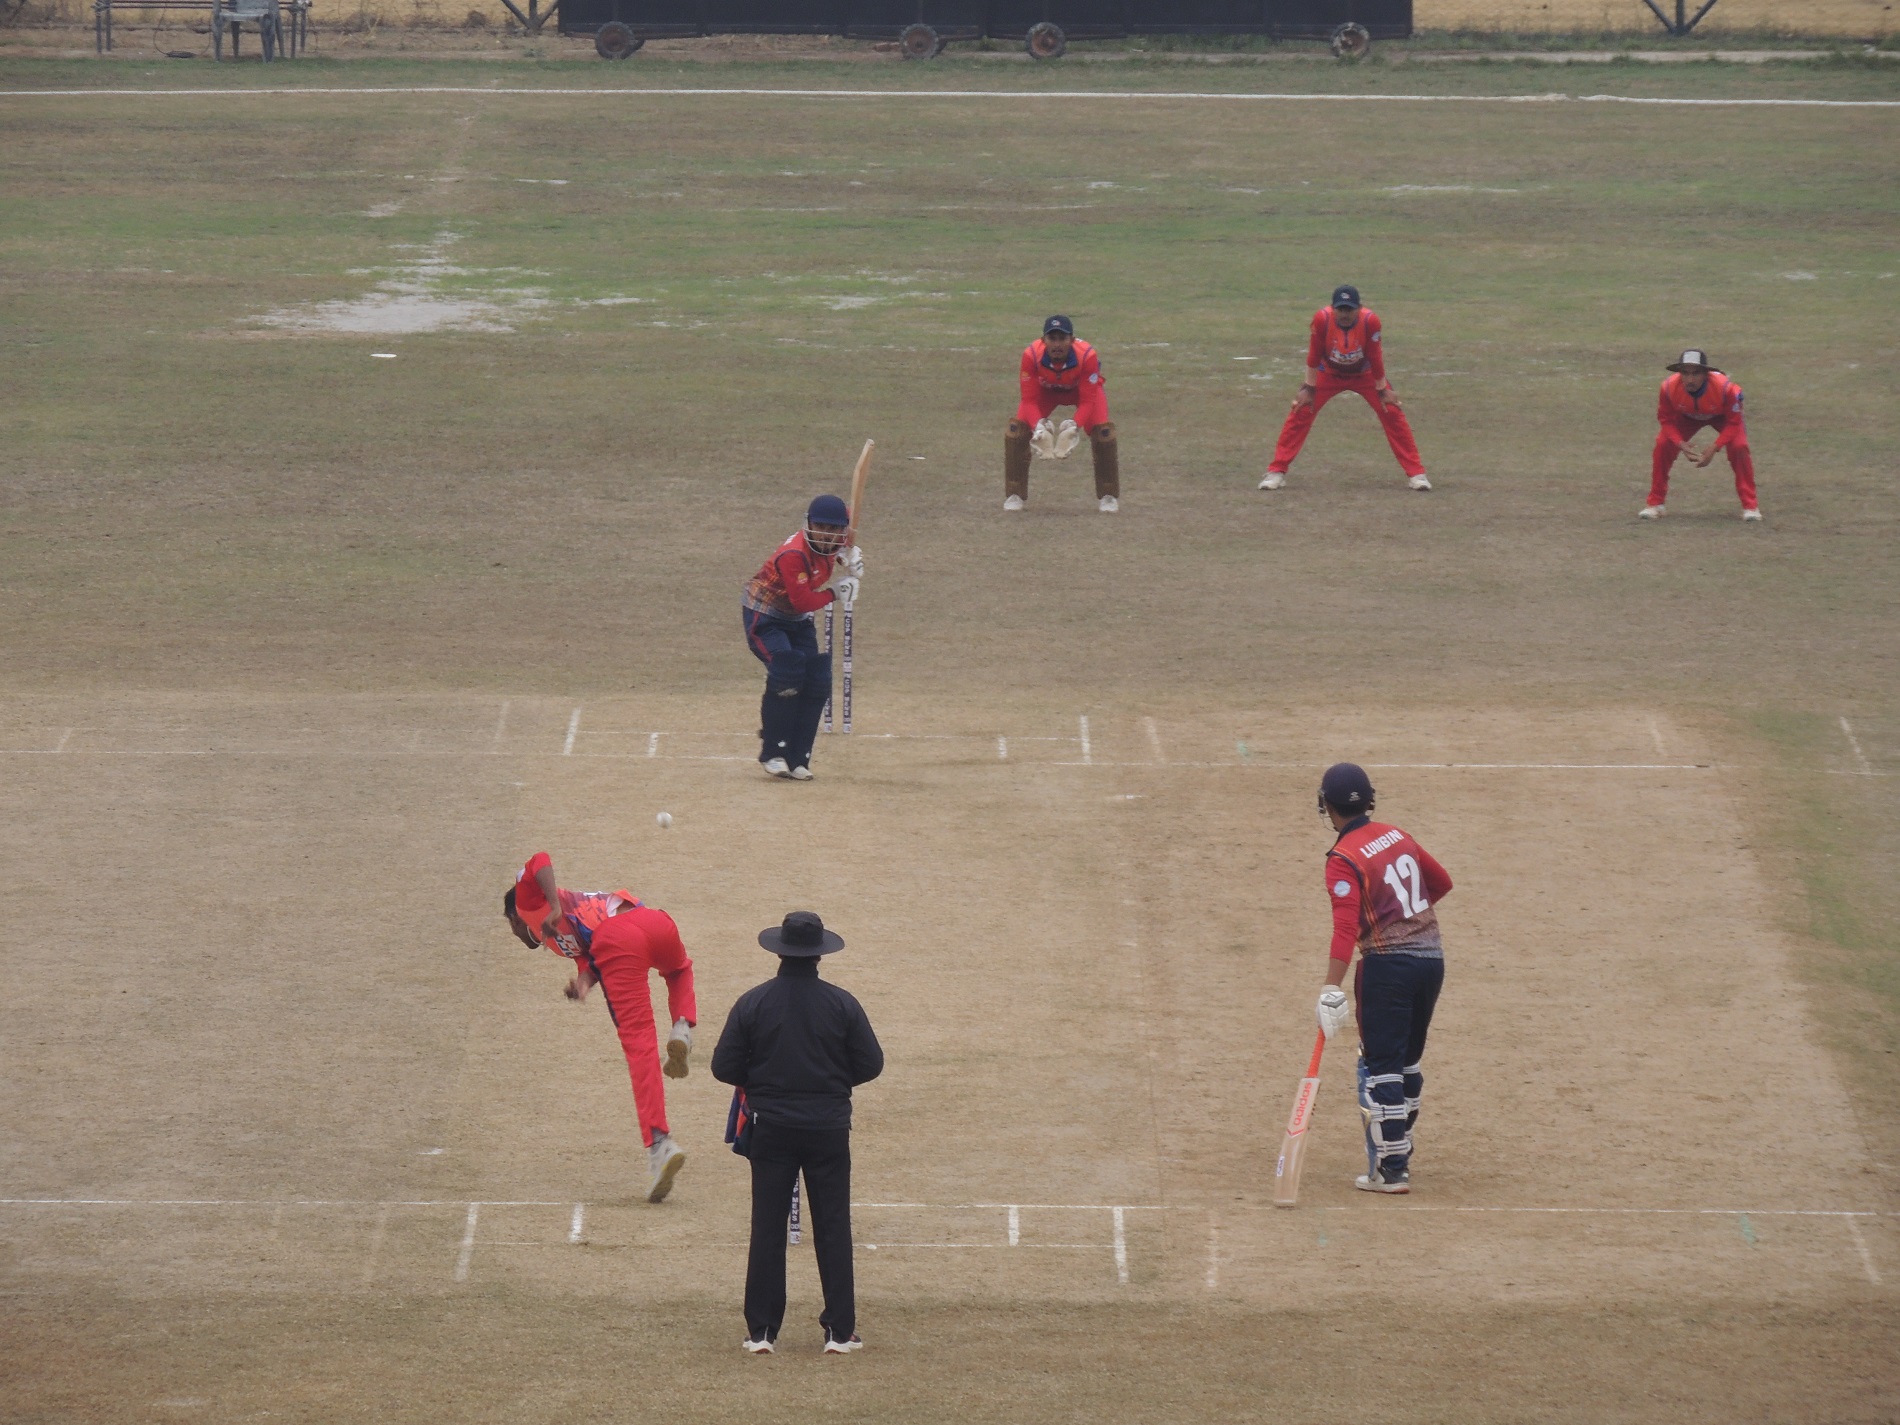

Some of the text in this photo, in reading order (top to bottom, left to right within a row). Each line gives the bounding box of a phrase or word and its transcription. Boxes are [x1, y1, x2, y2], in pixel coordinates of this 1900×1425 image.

[1359, 829, 1404, 859] LUMBINI
[1383, 853, 1429, 919] 12
[1293, 1082, 1312, 1126] adidas
